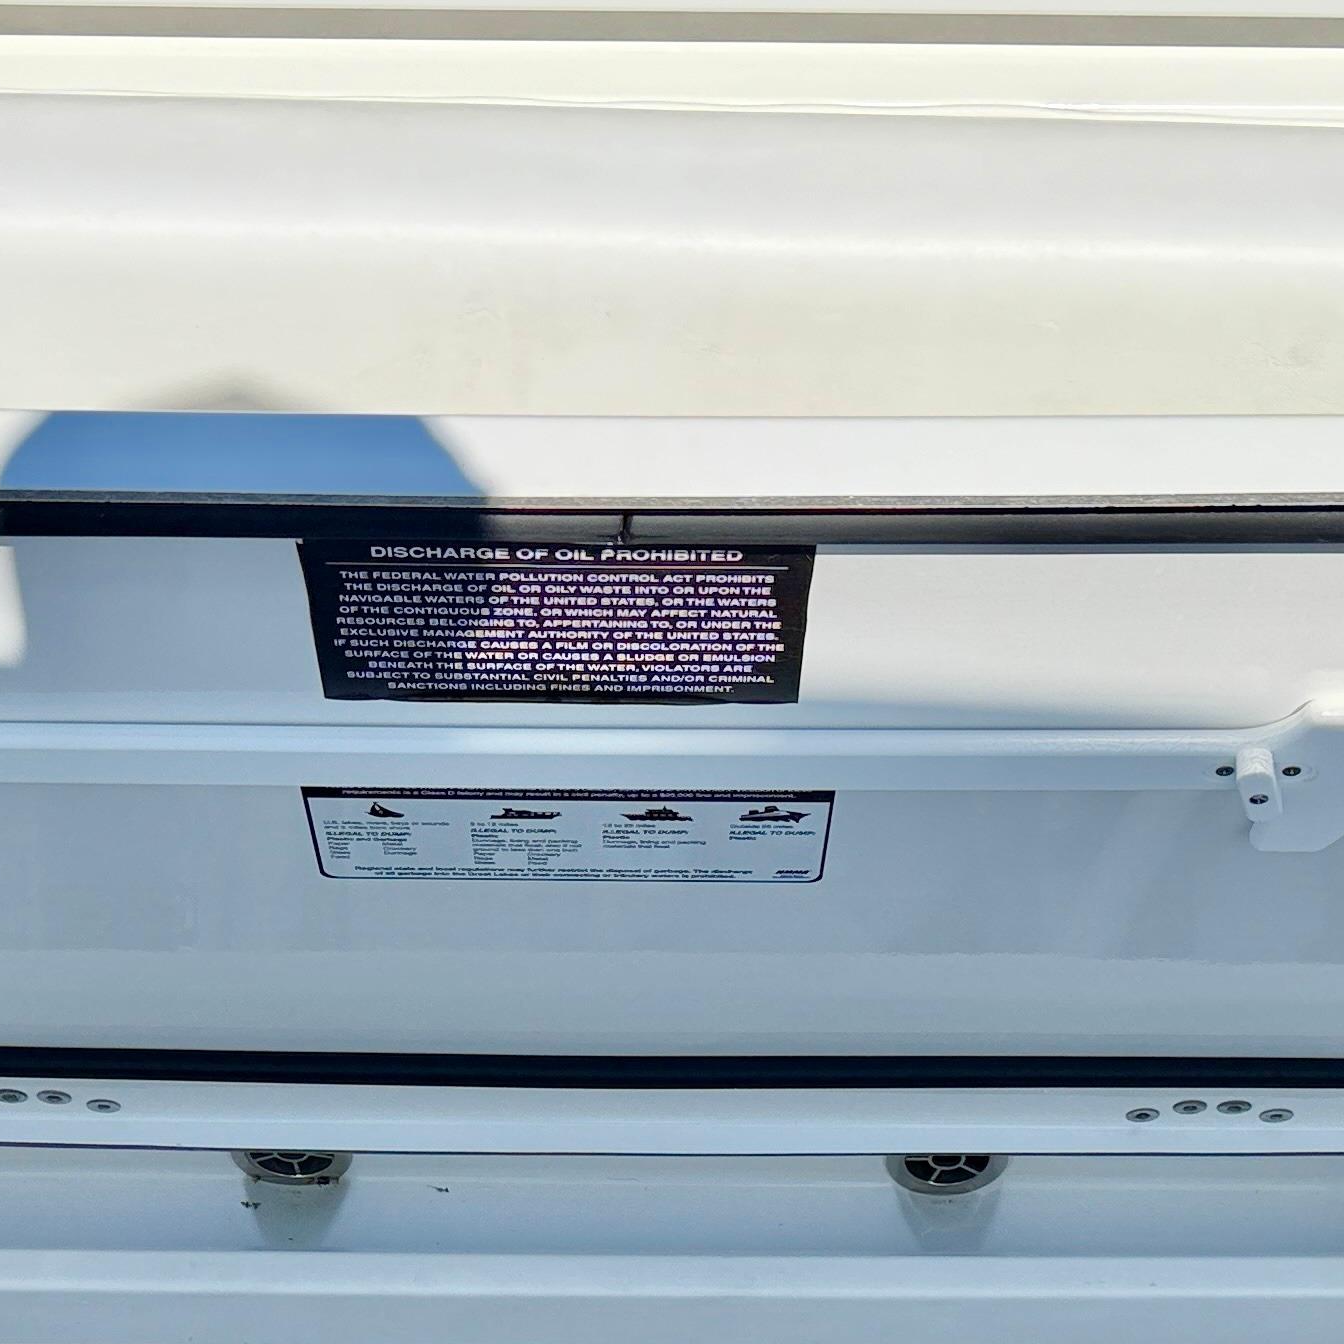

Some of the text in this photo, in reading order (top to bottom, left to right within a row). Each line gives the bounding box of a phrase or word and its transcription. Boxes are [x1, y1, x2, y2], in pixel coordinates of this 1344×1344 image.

[371, 547, 744, 561] DISCHARGE OF OIL PROHIBITED
[339, 571, 775, 583] THE FEDERAL WATER POLLUTION CONTROL ACT PROHIBITS
[344, 583, 772, 595] THE DISCHARGE OF OIL OR OILY WASTE INTO OR UPON THE
[339, 594, 422, 604] NAVIGABLE
[424, 595, 485, 604] WATERS
[488, 596, 509, 605] OF
[510, 596, 540, 605] THE
[544, 596, 597, 605] UNITED
[662, 597, 684, 606] OR
[686, 598, 715, 606] THE
[717, 598, 777, 607] WATERS
[339, 606, 359, 614] OF
[361, 606, 389, 615] THE
[394, 606, 490, 616] CONTIGUOUS
[540, 608, 563, 616] OR
[564, 608, 613, 617] WHICH
[616, 609, 647, 617] MAY
[650, 609, 708, 618] AFFECT
[710, 609, 778, 618] NATURAL
[336, 617, 425, 626] RESOURCES
[429, 618, 515, 627] BELONGING
[543, 619, 648, 628] APPERTAINING
[676, 620, 697, 629] OR
[701, 621, 751, 629] UNDER
[753, 621, 783, 630] THE
[340, 628, 419, 637] EXCLUSIVE
[423, 629, 525, 638] MANAGEMENT
[528, 630, 609, 639] AUTHORITY
[612, 631, 633, 639] OF
[634, 631, 663, 640] THE
[666, 631, 719, 640] UNITED
[350, 640, 389, 648] SUCH
[393, 640, 477, 649] DISCHARGE
[480, 641, 539, 649] CAUSES
[542, 641, 553, 649] A
[556, 641, 589, 650] FILM
[592, 642, 613, 650] OR
[616, 642, 733, 651] DISCOLORATION
[736, 643, 755, 651] OF
[757, 643, 786, 652] THE
[345, 650, 777, 662] SURFACE OF THE WATER OR CAUSES A SLUDGE OR EMULSION
[368, 661, 433, 669] BENEATH
[436, 662, 463, 670] THE
[467, 662, 532, 670] SURFACE
[536, 663, 555, 671] OF
[556, 663, 585, 671] THE
[641, 664, 719, 672] VIOLATORS
[723, 665, 754, 673] ARE
[347, 672, 775, 684] SUBJECT TO SUBSTANTIAL CIVIL PENALTIES AND/OR CRIMINAL
[388, 682, 735, 693] SANCTIONS INCLUDING FINES AND IMPRISONMENT.
